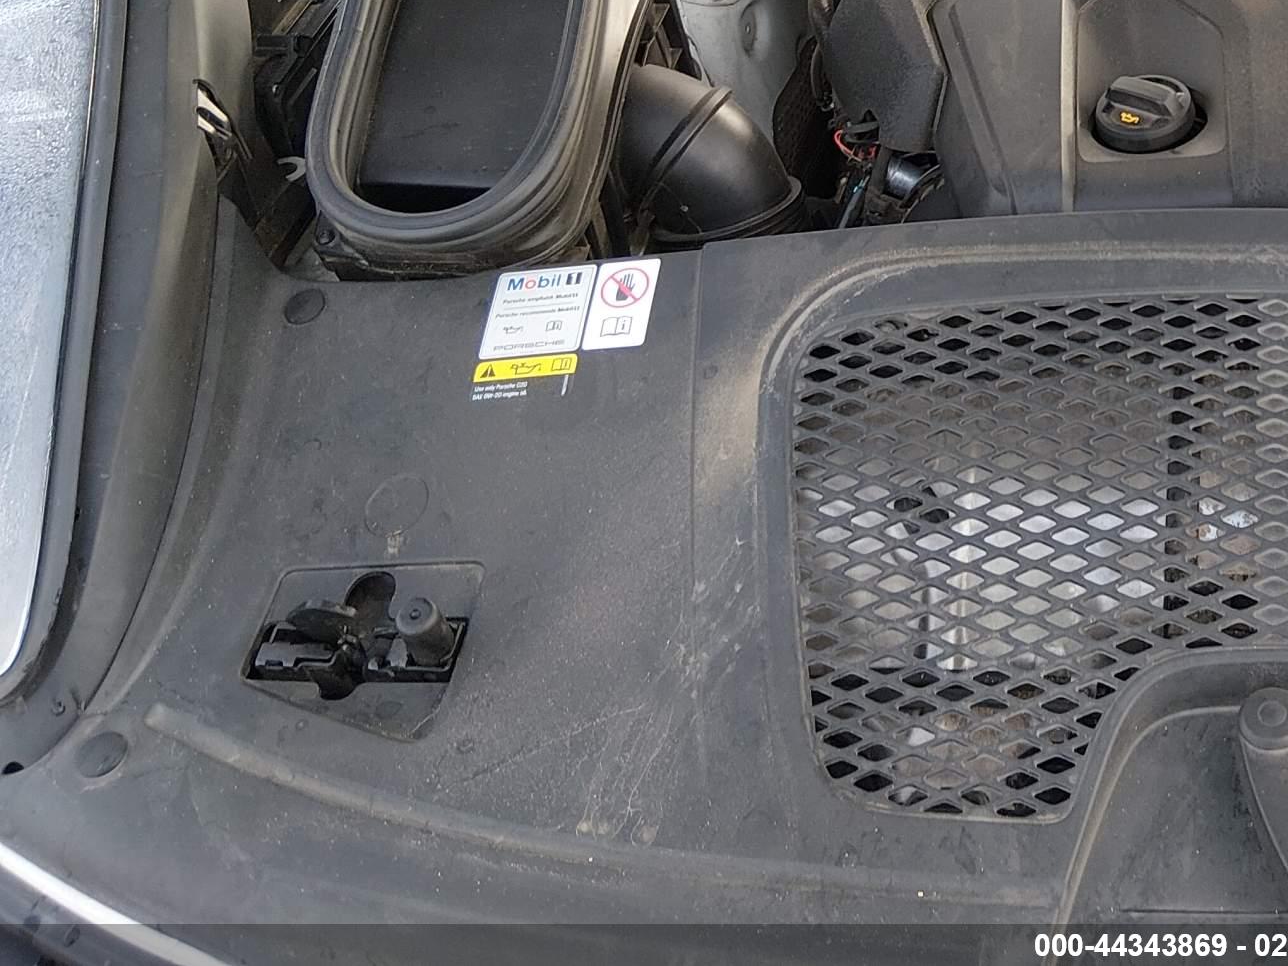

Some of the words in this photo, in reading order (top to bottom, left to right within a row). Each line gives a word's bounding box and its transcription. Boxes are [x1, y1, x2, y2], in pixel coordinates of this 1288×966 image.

[507, 273, 561, 291] Mobil
[566, 272, 583, 286] 1
[493, 339, 565, 351] PORSCHE
